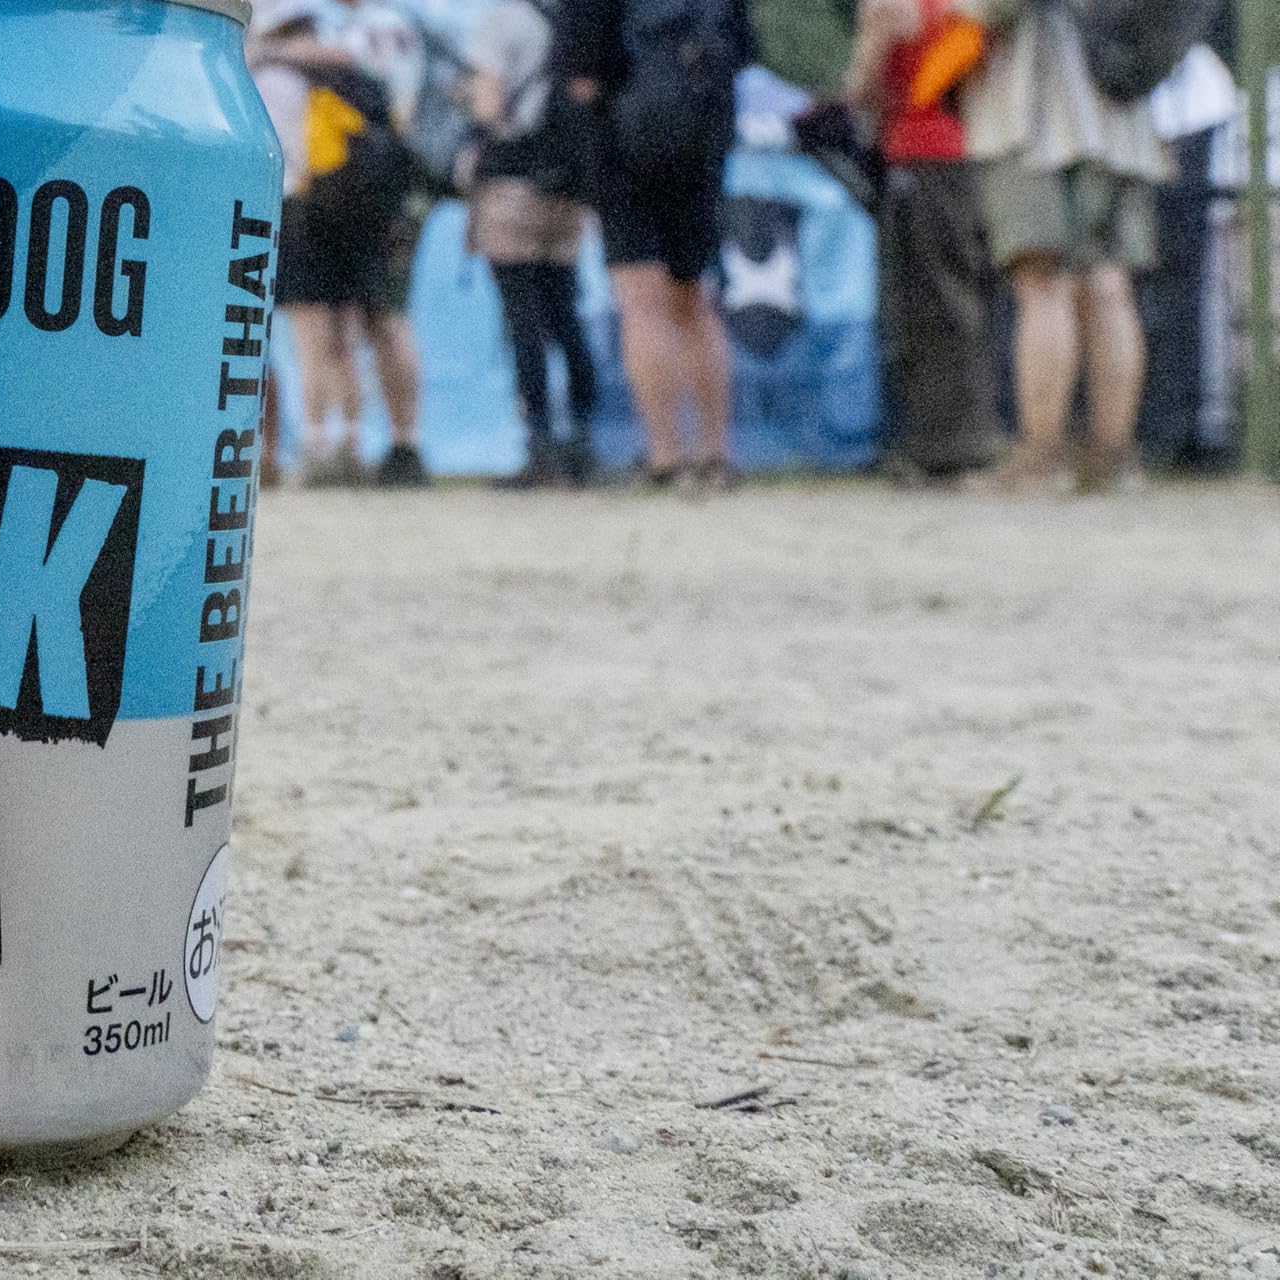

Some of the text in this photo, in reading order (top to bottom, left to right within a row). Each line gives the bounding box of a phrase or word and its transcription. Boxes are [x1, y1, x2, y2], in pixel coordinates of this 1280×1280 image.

[184, 200, 272, 828] THE BEER THAT
[87, 969, 173, 1014] ビール
[83, 1011, 172, 1056] 350ml
